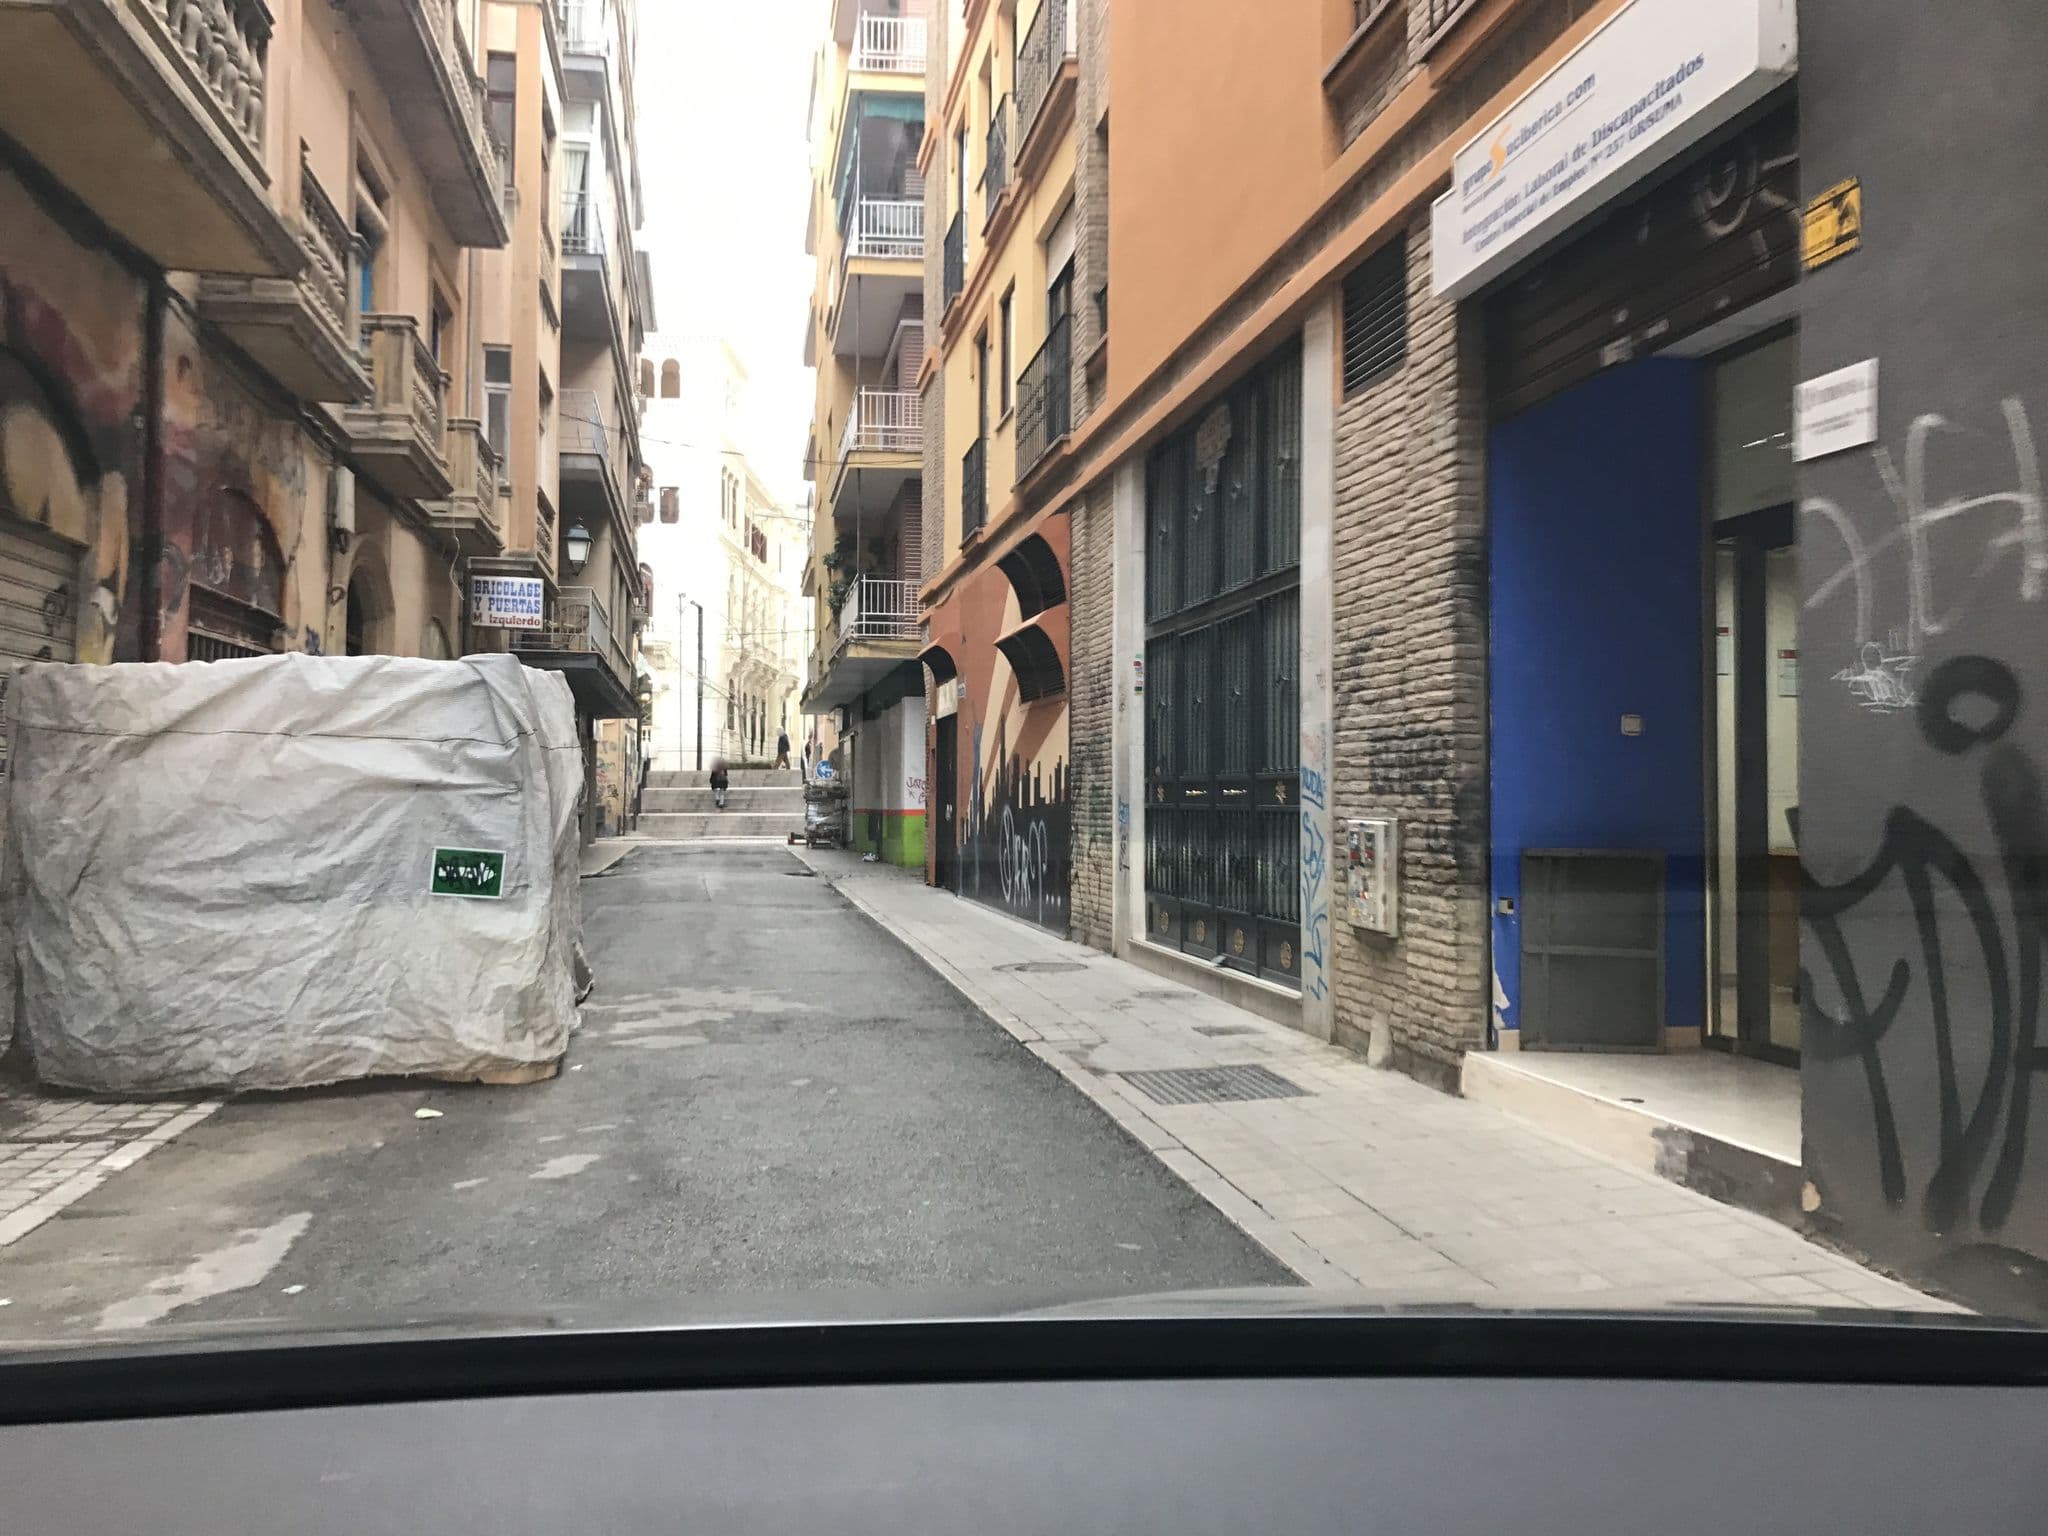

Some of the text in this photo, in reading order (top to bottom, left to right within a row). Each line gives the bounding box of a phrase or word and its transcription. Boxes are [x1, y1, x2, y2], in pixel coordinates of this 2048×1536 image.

[1524, 152, 1568, 198] Laboral
[1572, 141, 1587, 163] de
[1591, 52, 1704, 148] Discapacitados
[474, 580, 541, 598] BRICOLAGE
[474, 596, 541, 615] Y PUERTAS
[489, 614, 541, 626] Izquierdo
